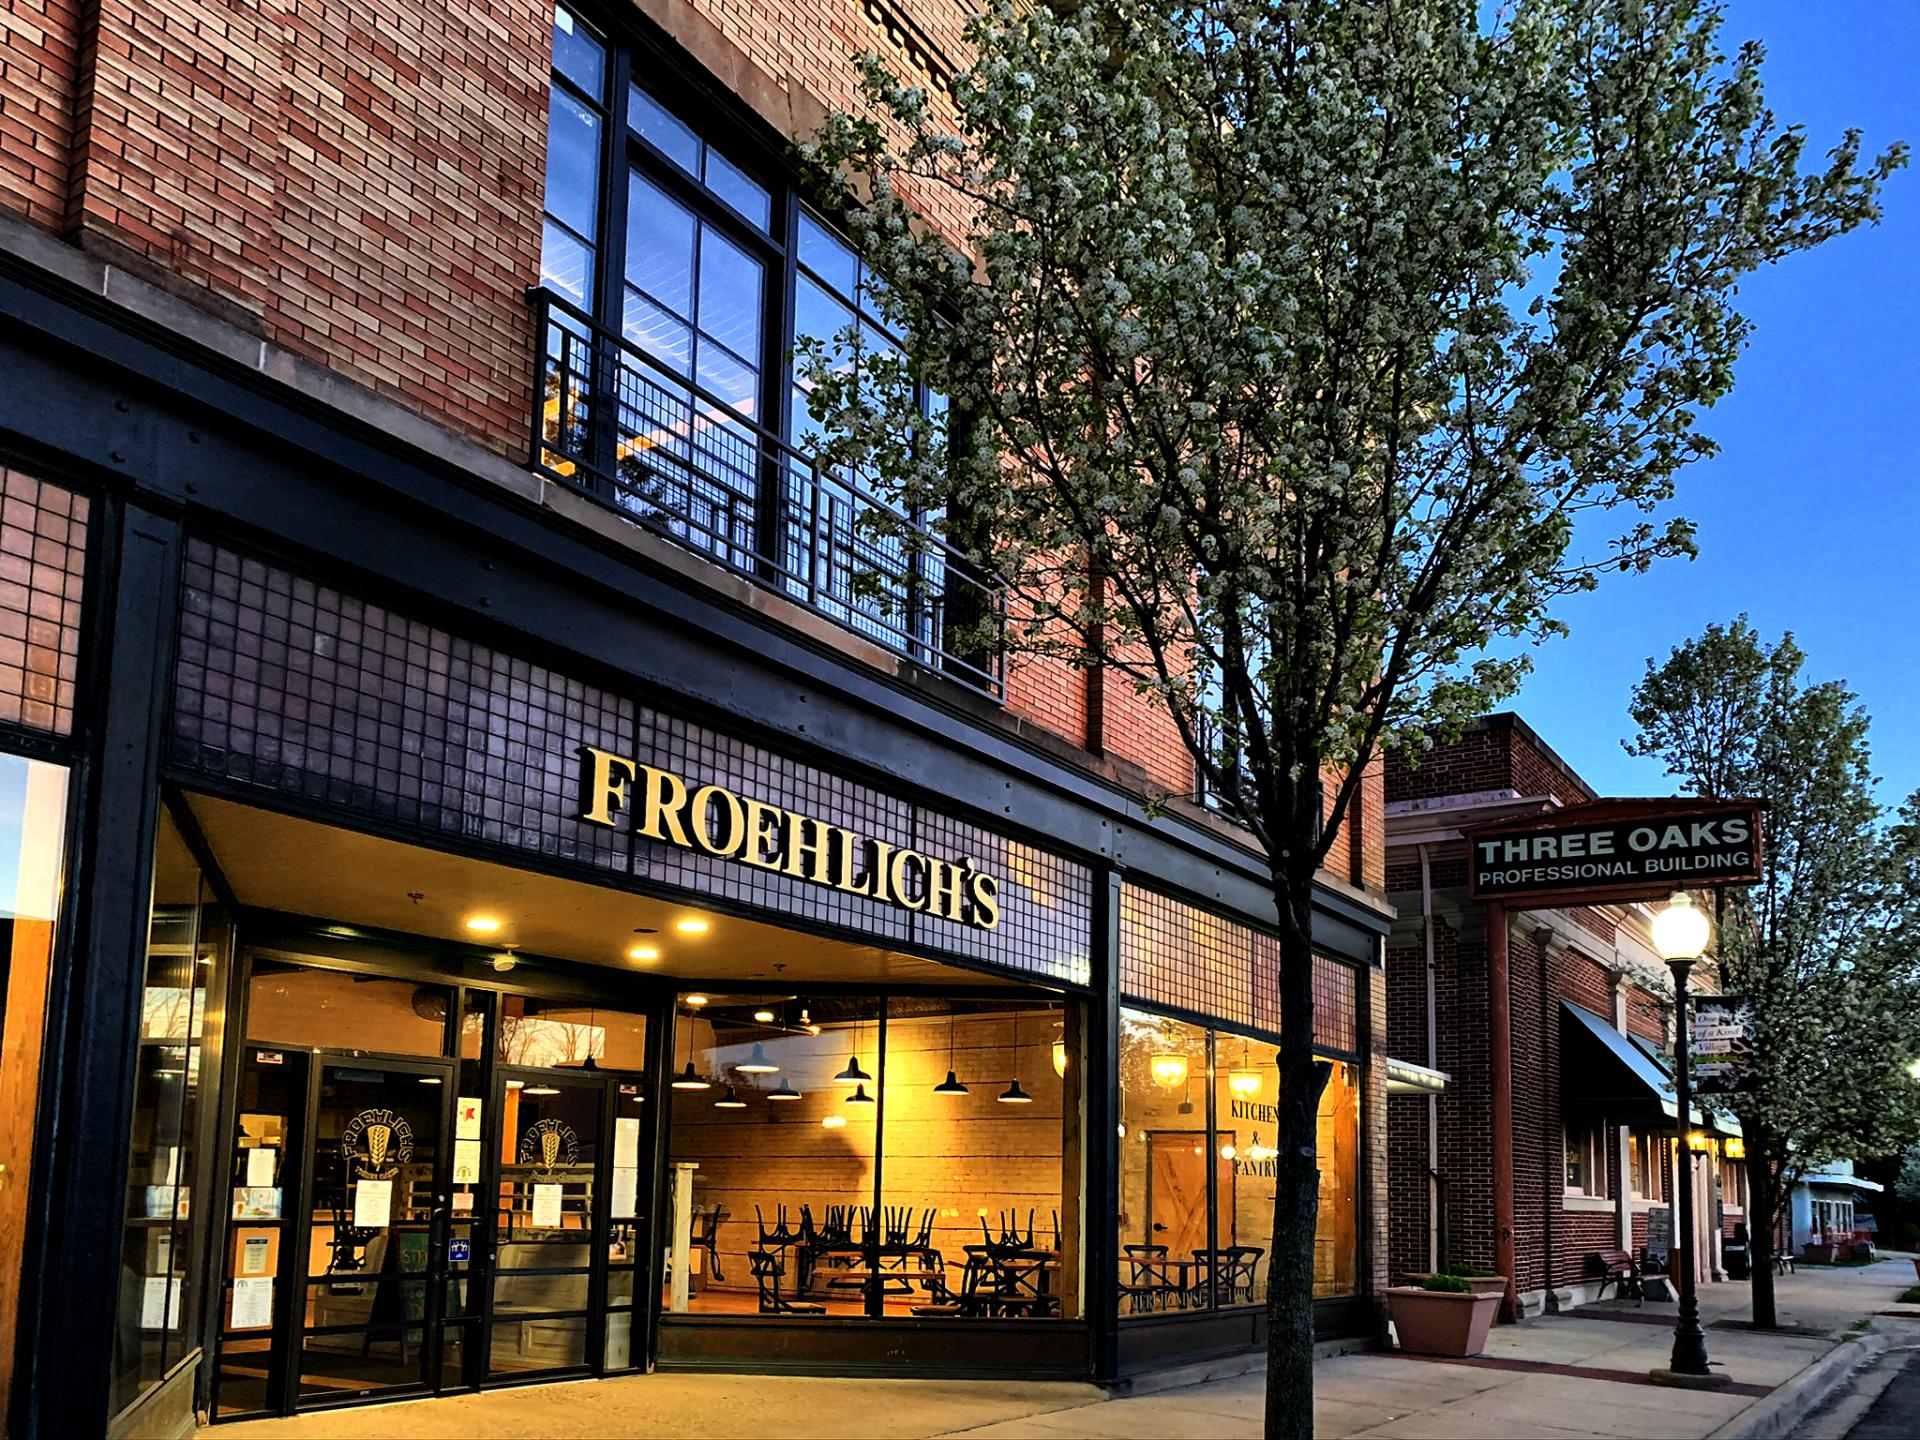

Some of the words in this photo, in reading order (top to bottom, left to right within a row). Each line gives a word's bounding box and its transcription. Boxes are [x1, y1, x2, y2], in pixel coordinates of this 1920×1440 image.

[583, 747, 1000, 930] FROEHLICH'S
[1479, 831, 1615, 864] THREE
[1628, 818, 1749, 852] OAKS
[1479, 861, 1639, 886] PROFESSIONAL
[1645, 851, 1750, 874] BUILDING
[1698, 1014, 1718, 1024] One
[1252, 1130, 1261, 1145] &
